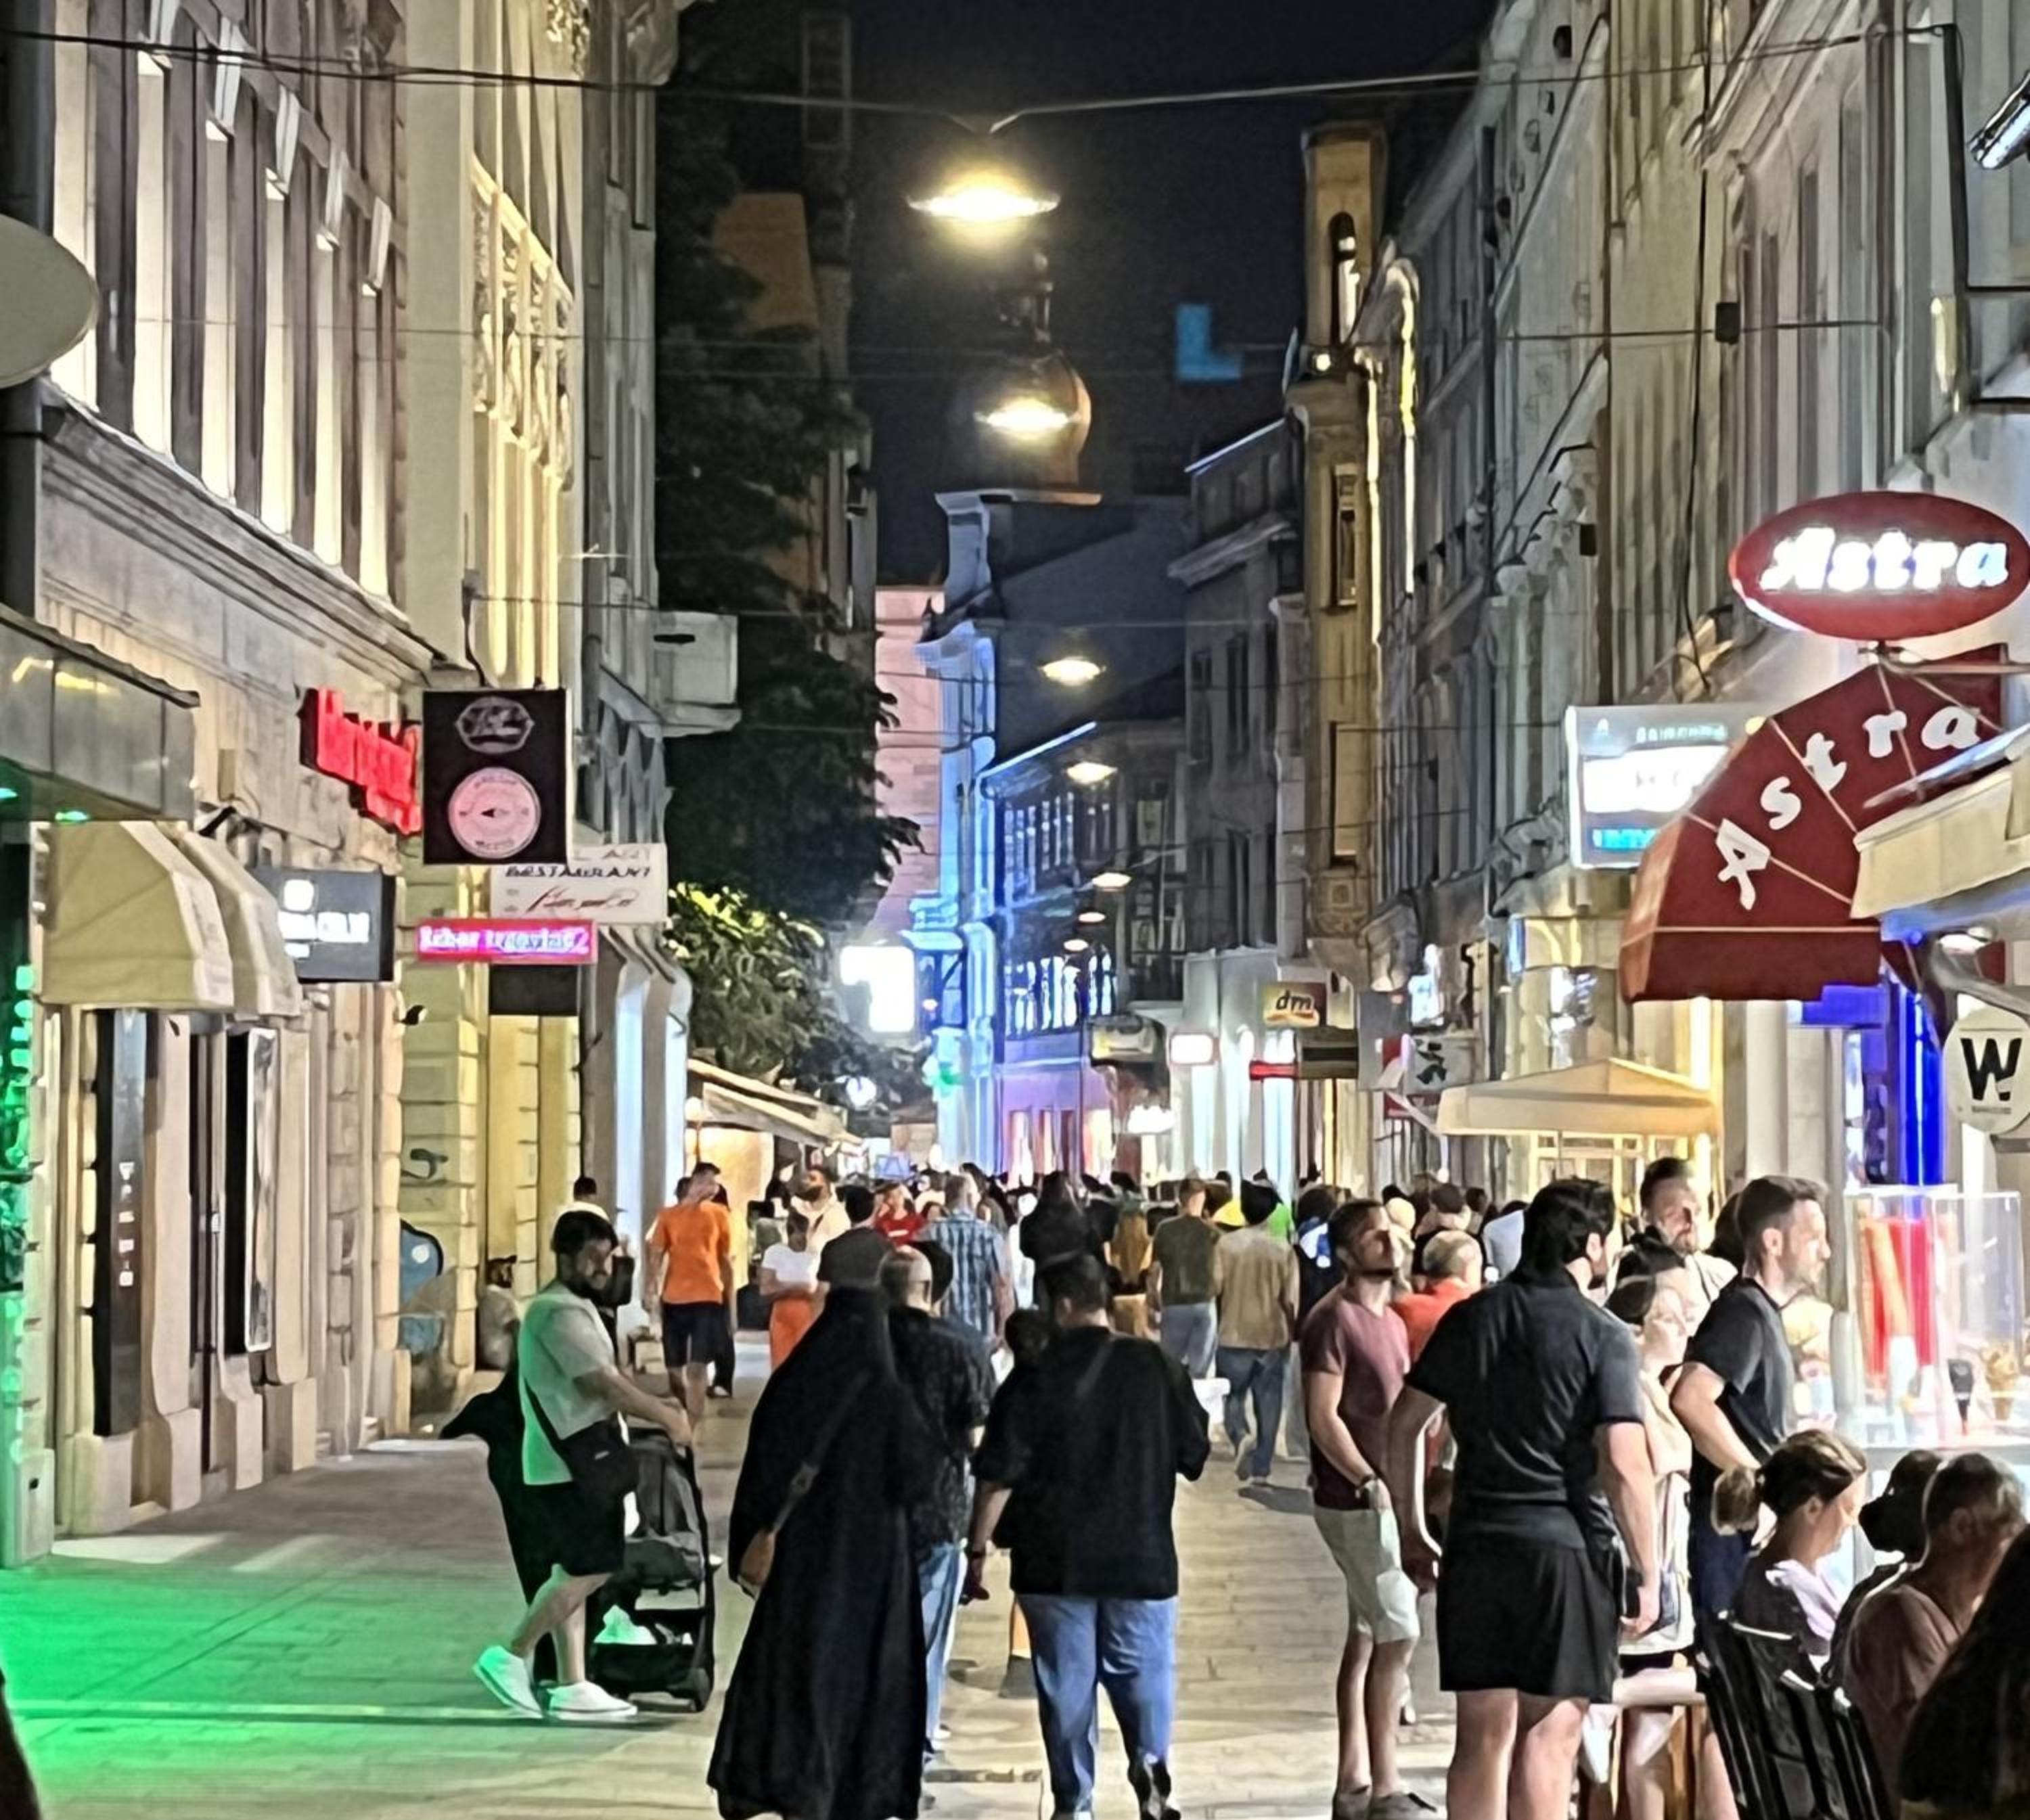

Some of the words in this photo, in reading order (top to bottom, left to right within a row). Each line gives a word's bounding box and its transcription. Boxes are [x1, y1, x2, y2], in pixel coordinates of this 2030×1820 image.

[1760, 527, 2009, 591] Astra
[1715, 706, 1983, 911] Astra
[1276, 990, 1312, 1010] dm
